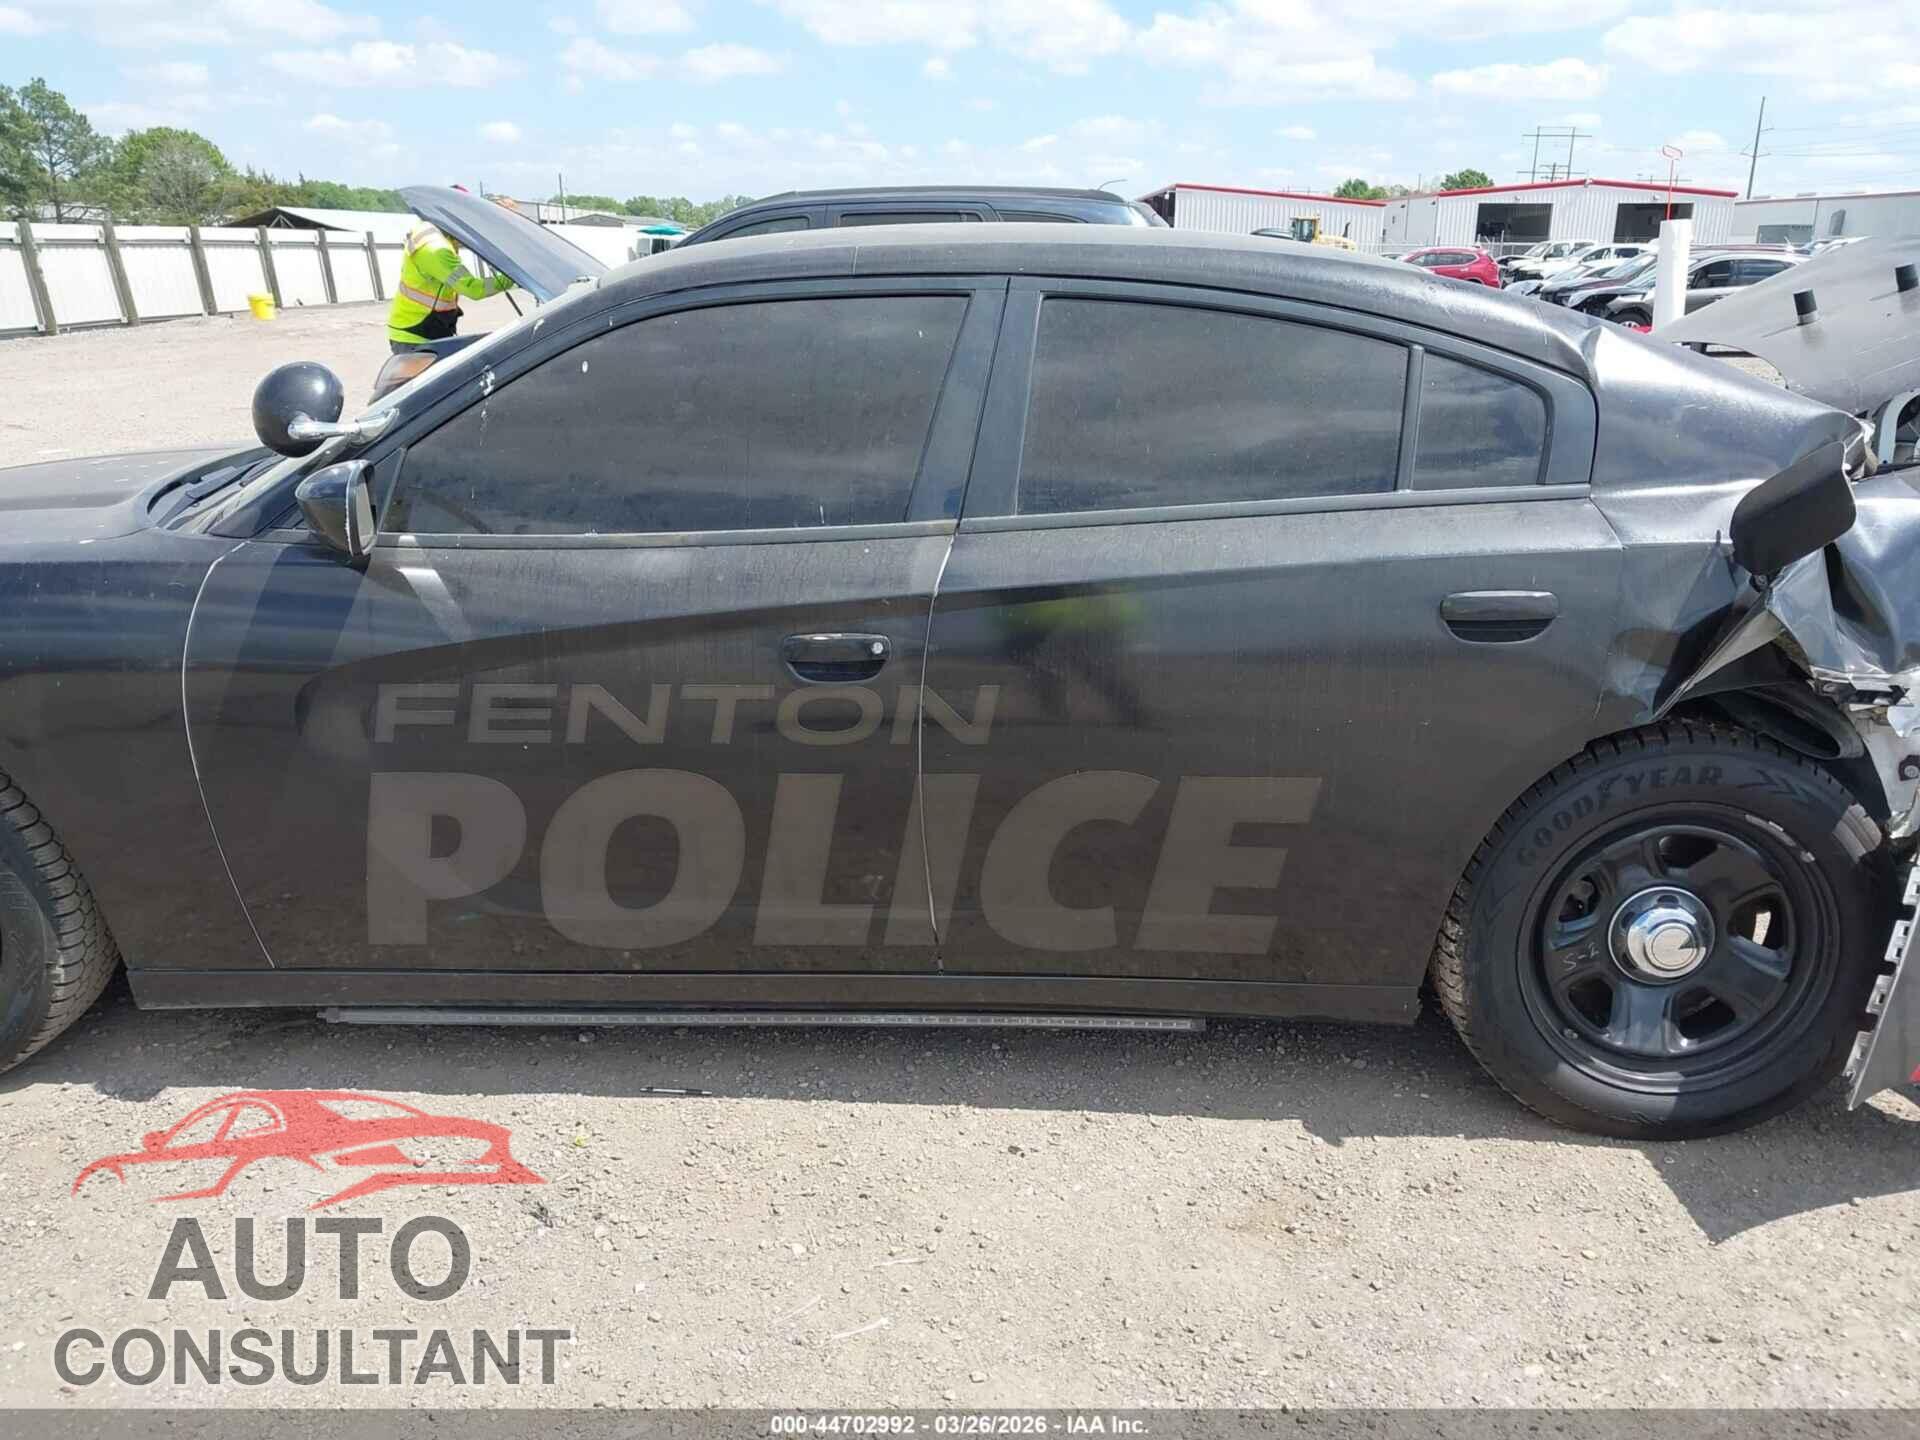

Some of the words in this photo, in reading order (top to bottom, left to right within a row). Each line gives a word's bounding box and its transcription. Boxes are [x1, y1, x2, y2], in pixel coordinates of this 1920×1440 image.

[374, 683, 1000, 745] FENTON
[367, 768, 1322, 956] POLICE
[1517, 765, 1725, 866] GOODYEAR
